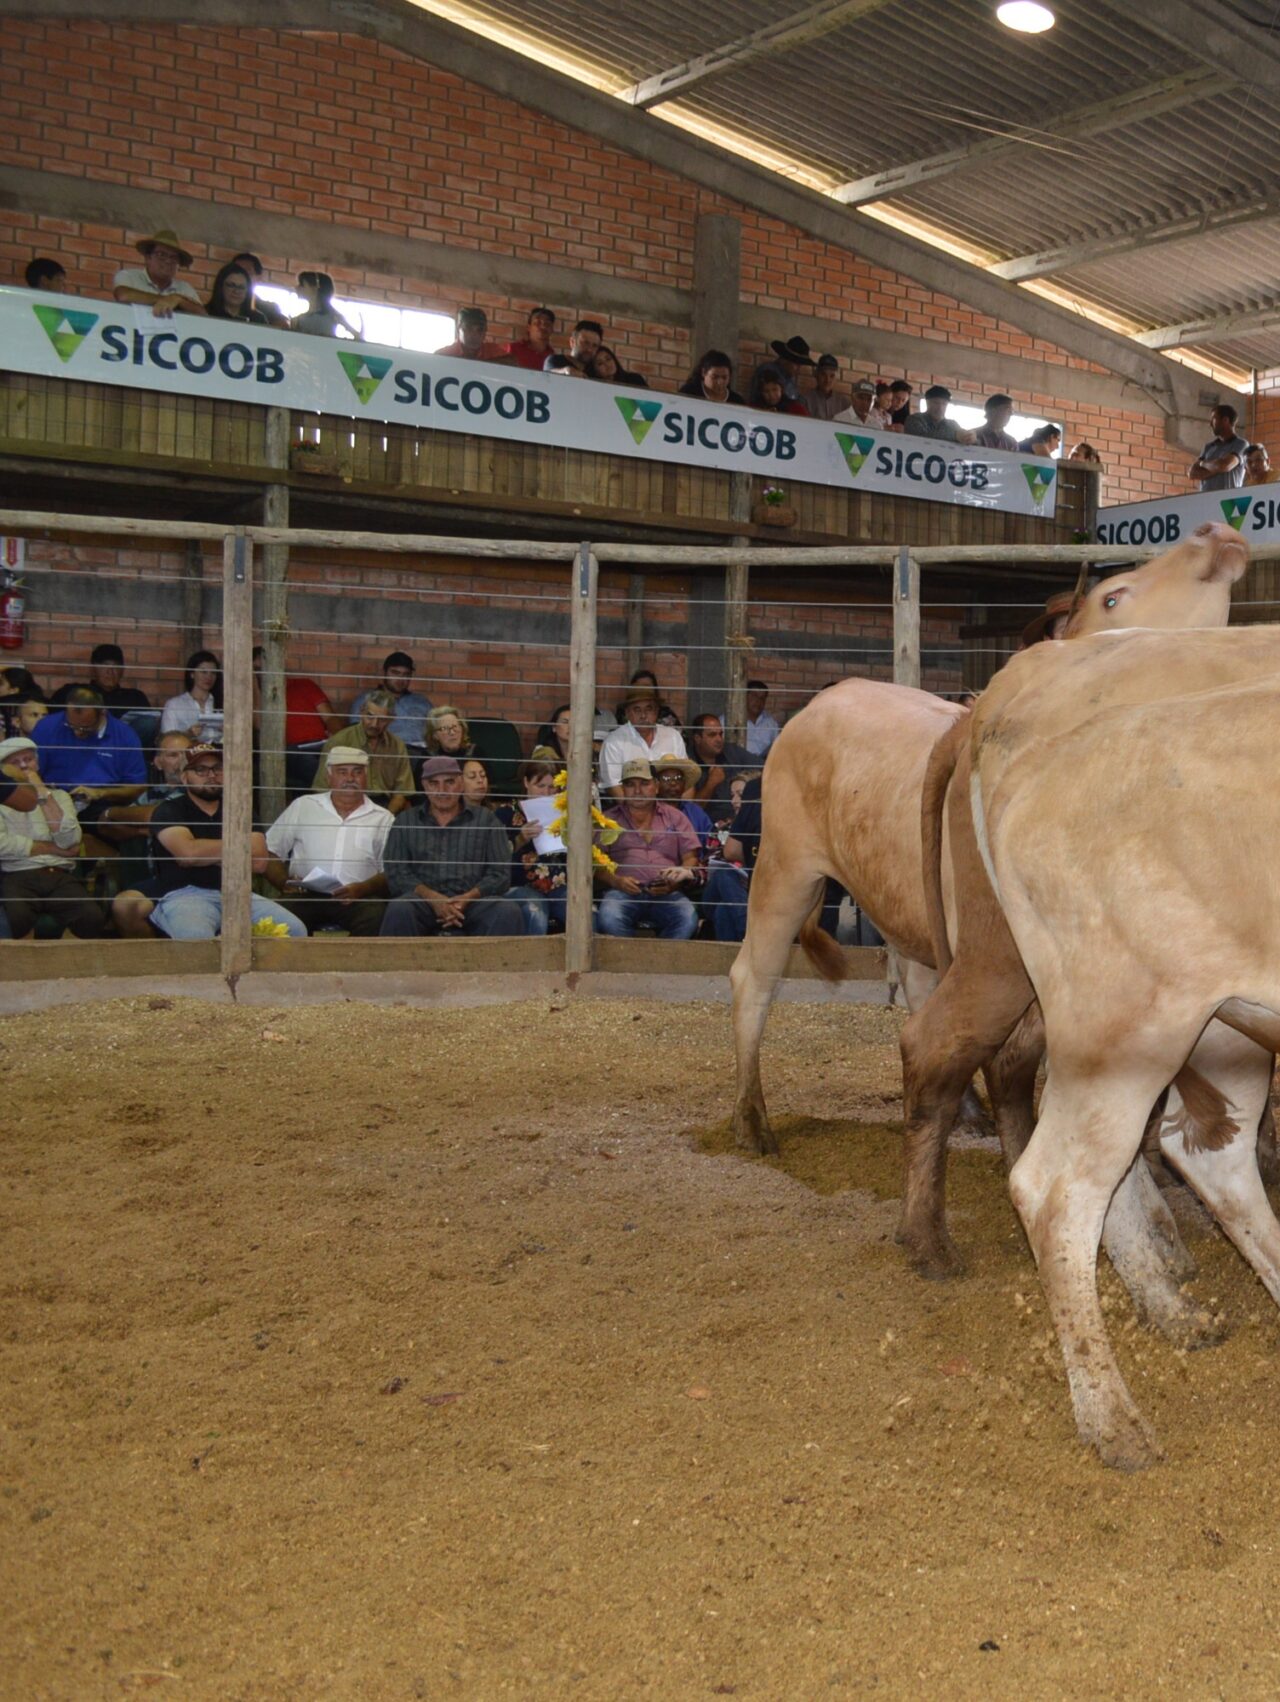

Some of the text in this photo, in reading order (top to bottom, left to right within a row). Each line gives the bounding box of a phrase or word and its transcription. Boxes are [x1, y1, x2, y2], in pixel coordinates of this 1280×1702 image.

[101, 325, 285, 384] SICOOB
[394, 369, 550, 423] SICOOB
[663, 412, 797, 460] SICOOB
[875, 446, 990, 490] SICOOB
[1096, 513, 1180, 545] SICOOB
